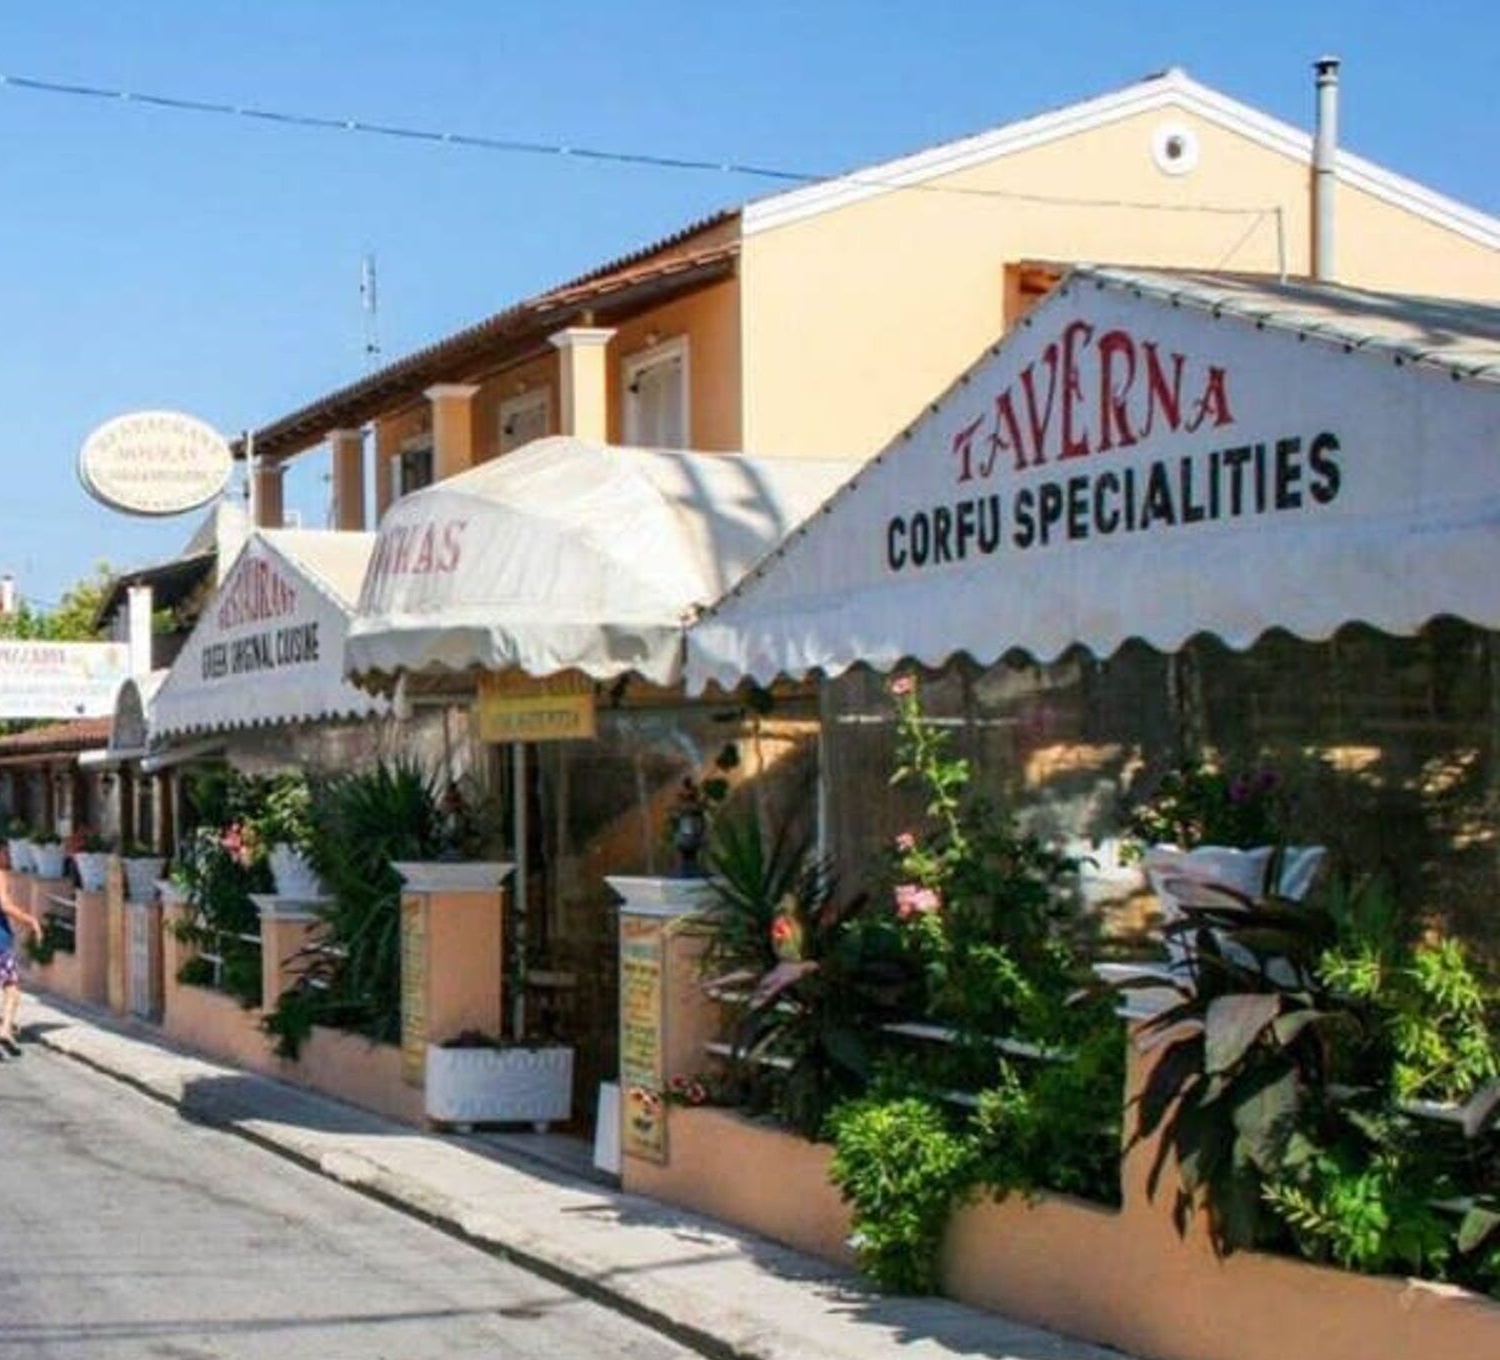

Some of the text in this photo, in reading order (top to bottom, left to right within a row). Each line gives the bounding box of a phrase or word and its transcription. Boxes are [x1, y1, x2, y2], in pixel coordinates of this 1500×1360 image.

[953, 320, 1235, 482] TAVERNA
[887, 431, 1342, 571] CORFU SPECIALITIES
[277, 621, 319, 666] CUISINE
